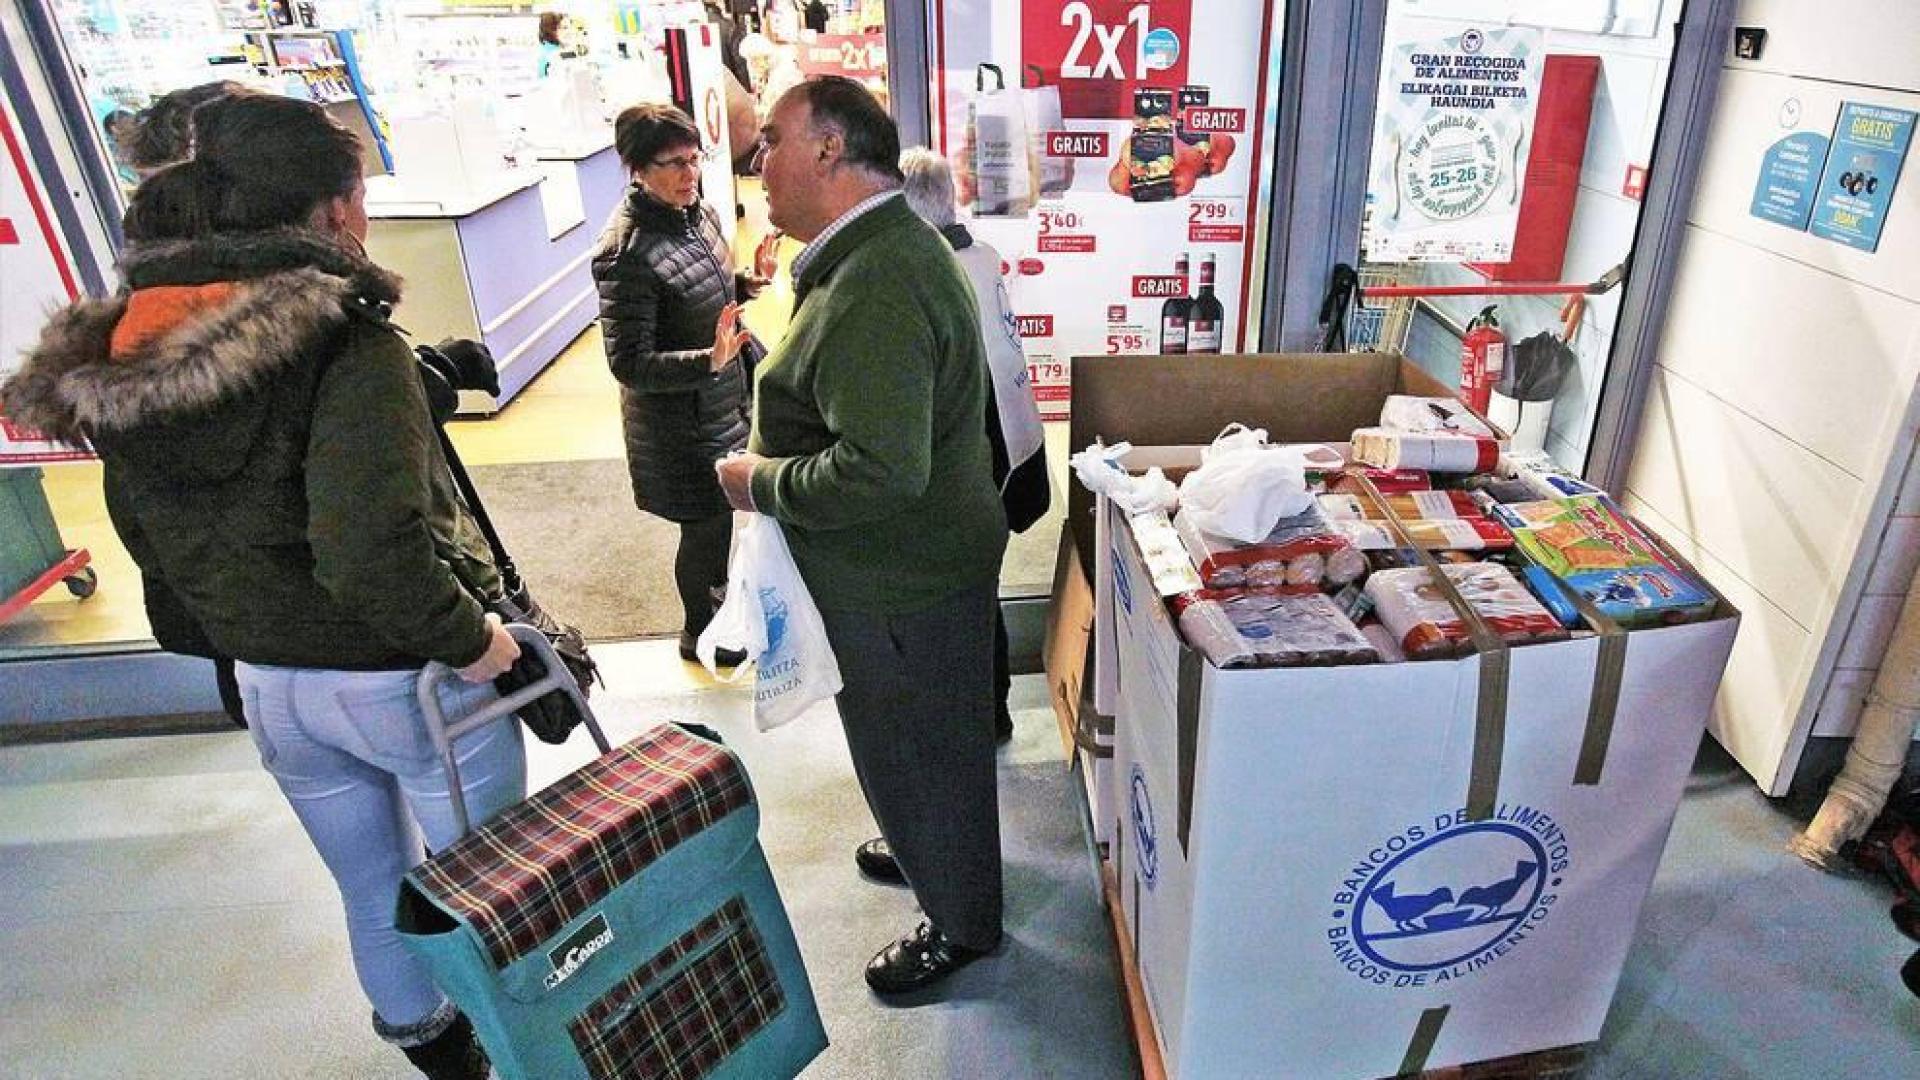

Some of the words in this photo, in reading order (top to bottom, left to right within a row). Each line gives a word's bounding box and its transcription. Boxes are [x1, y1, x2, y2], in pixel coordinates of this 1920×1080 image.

[1060, 1, 1149, 80] 2x1
[1409, 53, 1451, 66] GRAN
[1454, 55, 1526, 70] RECOGIDA
[1415, 67, 1435, 78] DE
[1437, 67, 1519, 81] ALIMENTOS
[1400, 83, 1467, 95] ELIKAGAI
[1470, 85, 1527, 98] BILKETA
[1430, 97, 1495, 109] HAUNDIA
[1191, 111, 1239, 129] GRATIS
[1052, 136, 1101, 154] GRATIS
[1430, 167, 1477, 188] 25-26
[1137, 278, 1182, 295] GRATIS
[1333, 825, 1425, 905] BANCOS
[1434, 808, 1469, 831] DE
[1496, 803, 1568, 874] LIMENTOS
[1327, 926, 1392, 985] BANCOS
[1394, 972, 1428, 988] DE
[1434, 893, 1558, 984] ALIMENTOS
